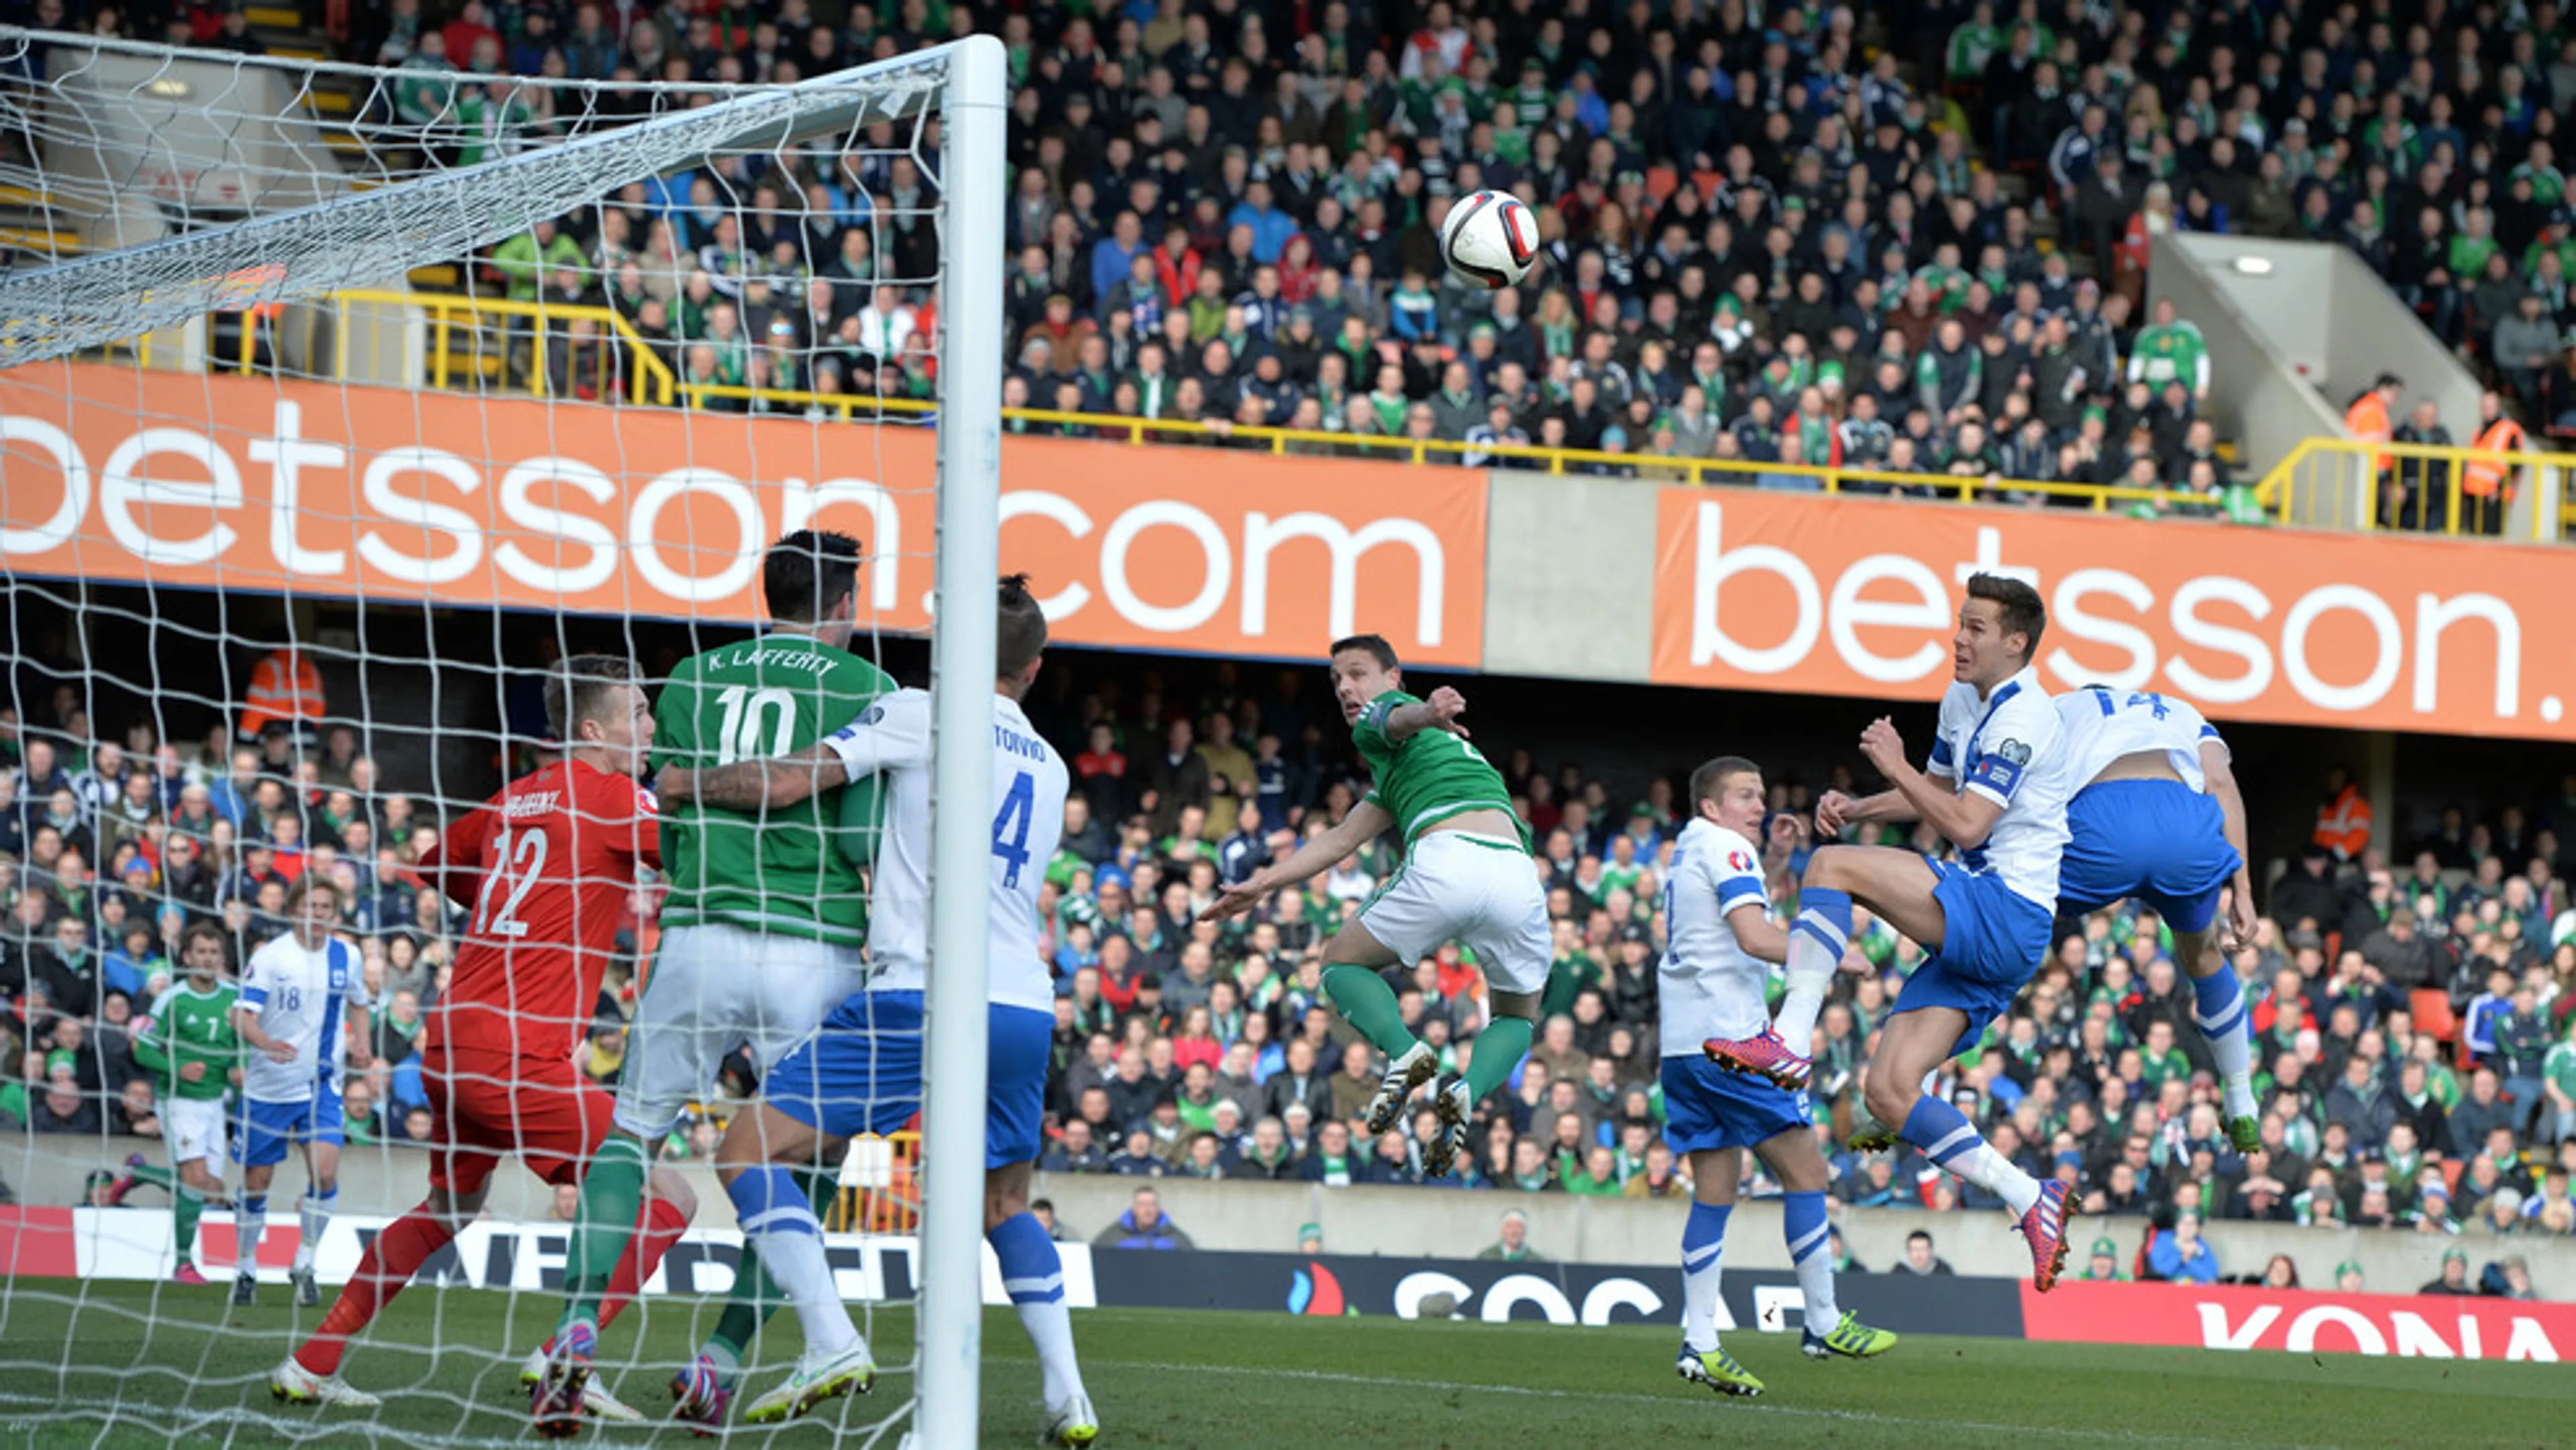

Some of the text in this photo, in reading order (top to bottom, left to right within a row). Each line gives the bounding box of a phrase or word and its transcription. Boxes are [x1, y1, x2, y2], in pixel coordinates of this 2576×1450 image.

[732, 648, 839, 678] LAFFERTY
[2093, 688, 2171, 722] 14
[714, 684, 797, 767] 10
[992, 770, 1034, 890] 4
[475, 827, 548, 937] 12
[277, 986, 301, 1012] 18
[206, 1017, 219, 1041] 7
